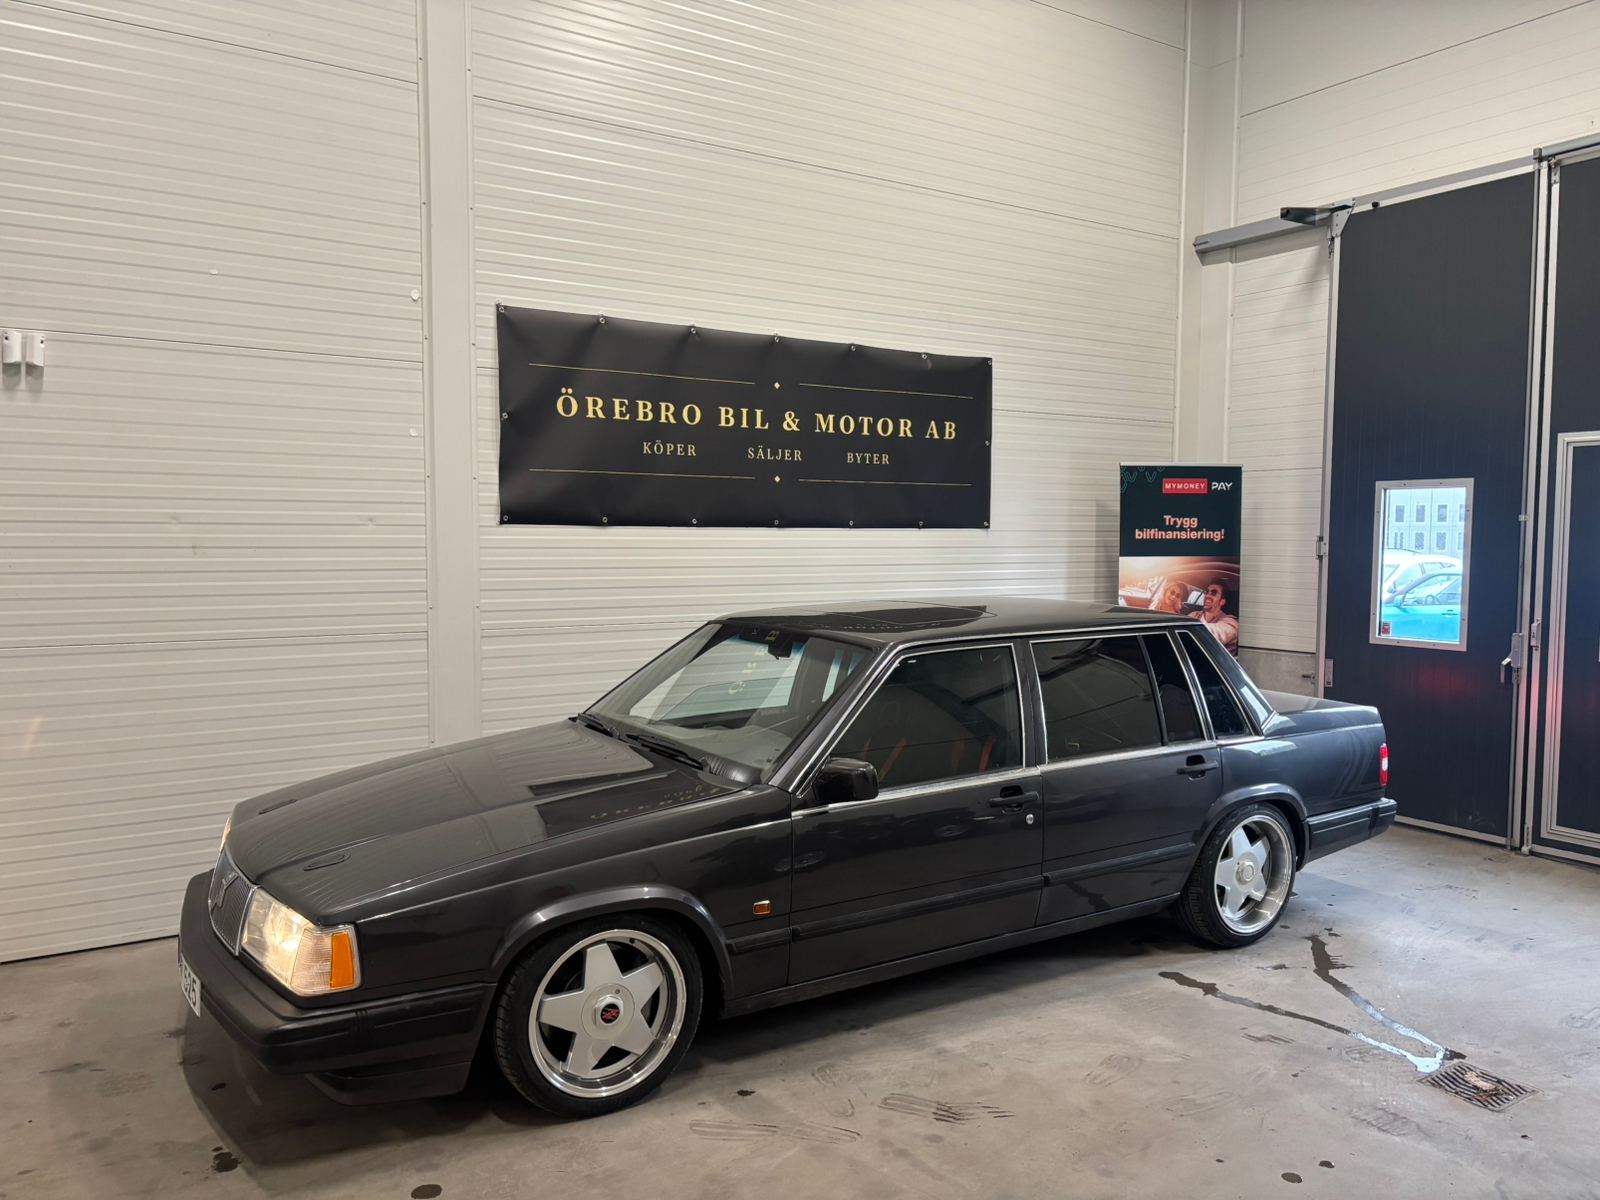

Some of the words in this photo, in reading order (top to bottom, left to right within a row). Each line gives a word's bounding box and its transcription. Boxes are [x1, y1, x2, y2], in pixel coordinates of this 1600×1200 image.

[556, 387, 702, 426] ÖREBRO
[718, 406, 769, 430] BIL
[782, 410, 801, 432] &
[814, 412, 913, 438] MOTOR
[924, 420, 957, 440] AB
[643, 439, 697, 457] KÖPER
[747, 444, 802, 462] SÄLJER
[846, 452, 890, 465] BYTER
[1211, 481, 1233, 491] PAY
[1163, 515, 1198, 528] Trygg
[1135, 528, 1225, 542] bilfinansiering!
